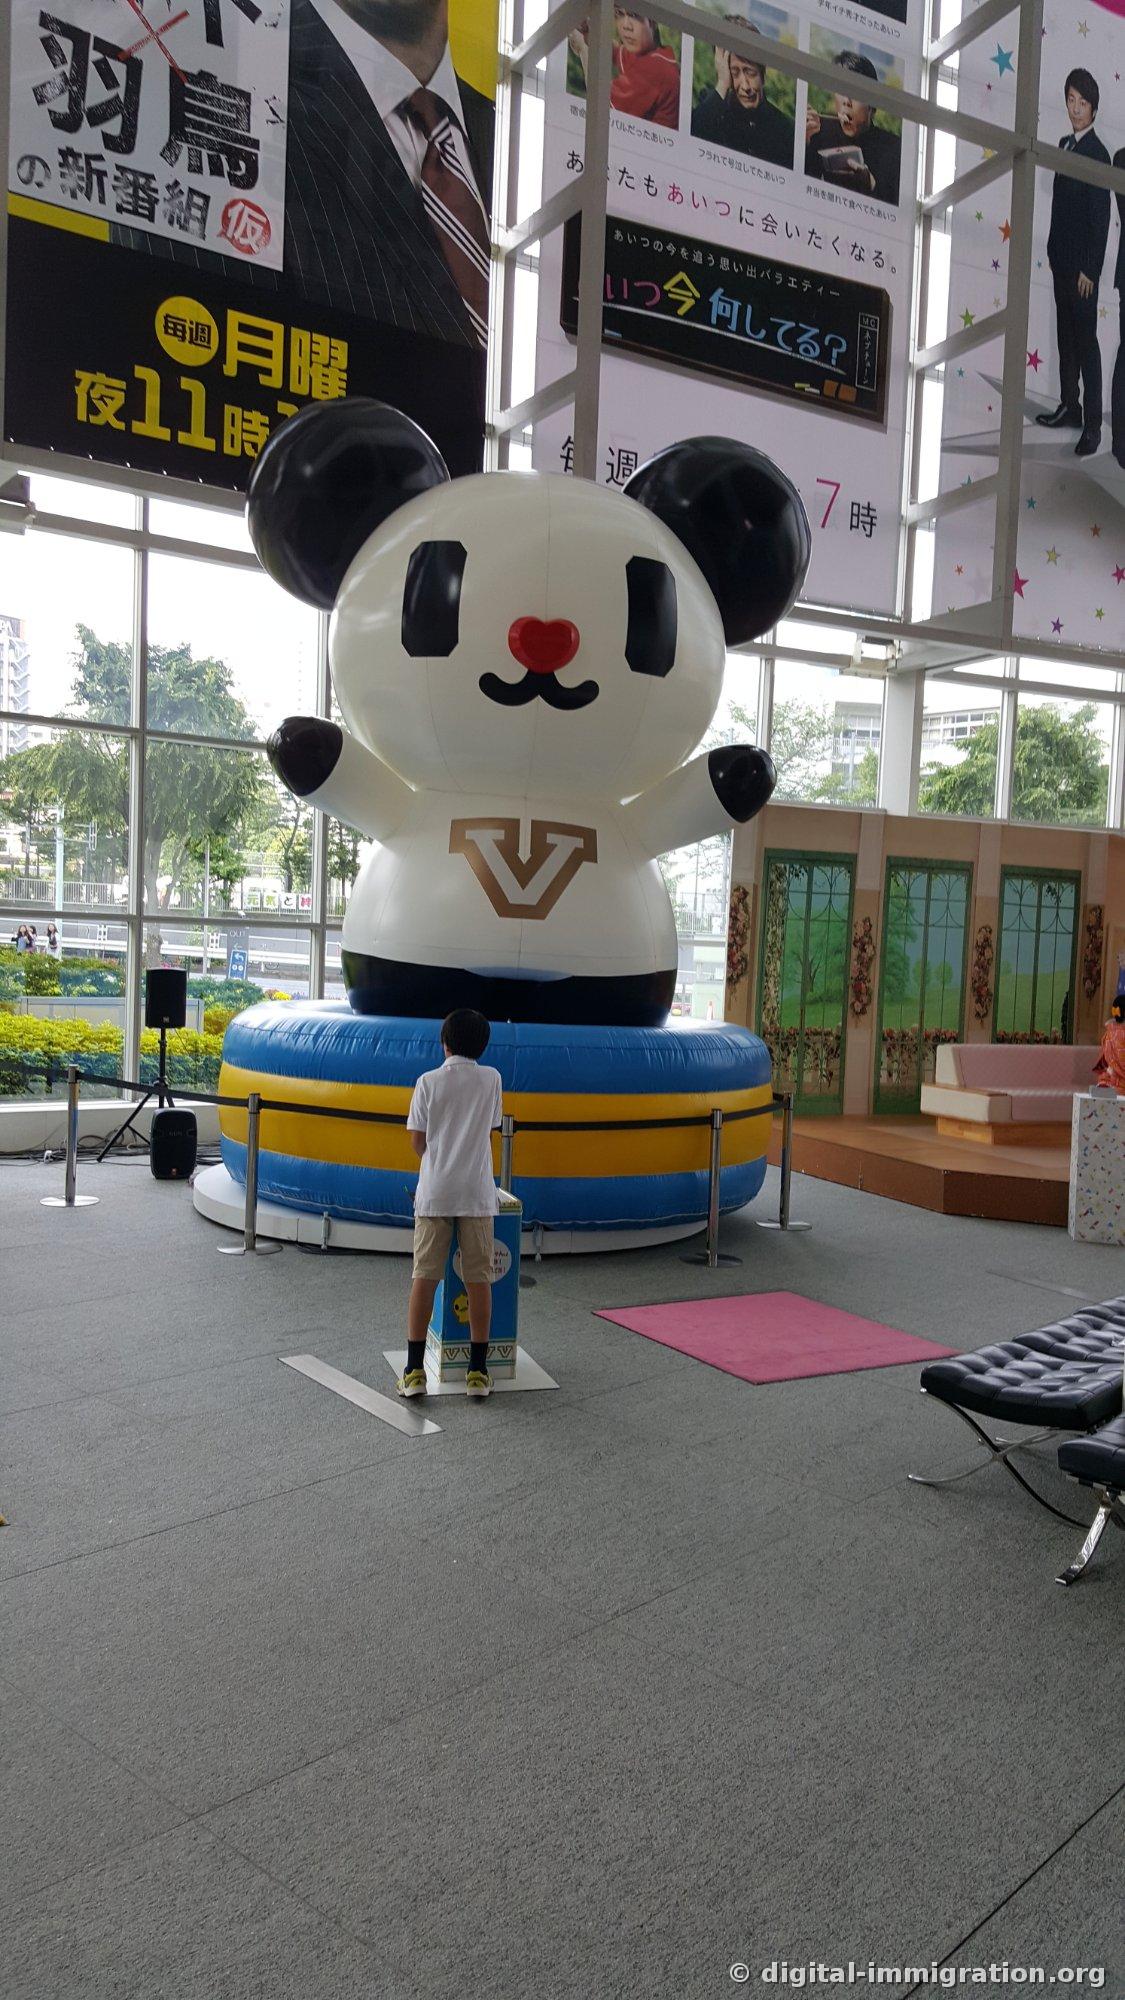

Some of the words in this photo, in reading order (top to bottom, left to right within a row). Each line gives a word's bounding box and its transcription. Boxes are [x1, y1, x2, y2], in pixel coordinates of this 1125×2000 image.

[32, 10, 260, 190] 羽鳥
[17, 146, 211, 241] の新番組
[219, 199, 271, 255] 仮
[566, 150, 897, 274] あたもあいつに会いたくなる。
[698, 148, 786, 185] フラれて号泣してたあいつ
[614, 229, 840, 297] あいつの今を追う思い出バラエティー
[163, 313, 212, 350] 毎週
[223, 308, 348, 400] 月曜
[604, 271, 847, 366] いつ今何してる?
[74, 364, 299, 458] 夜11時
[816, 477, 877, 538] 7時
